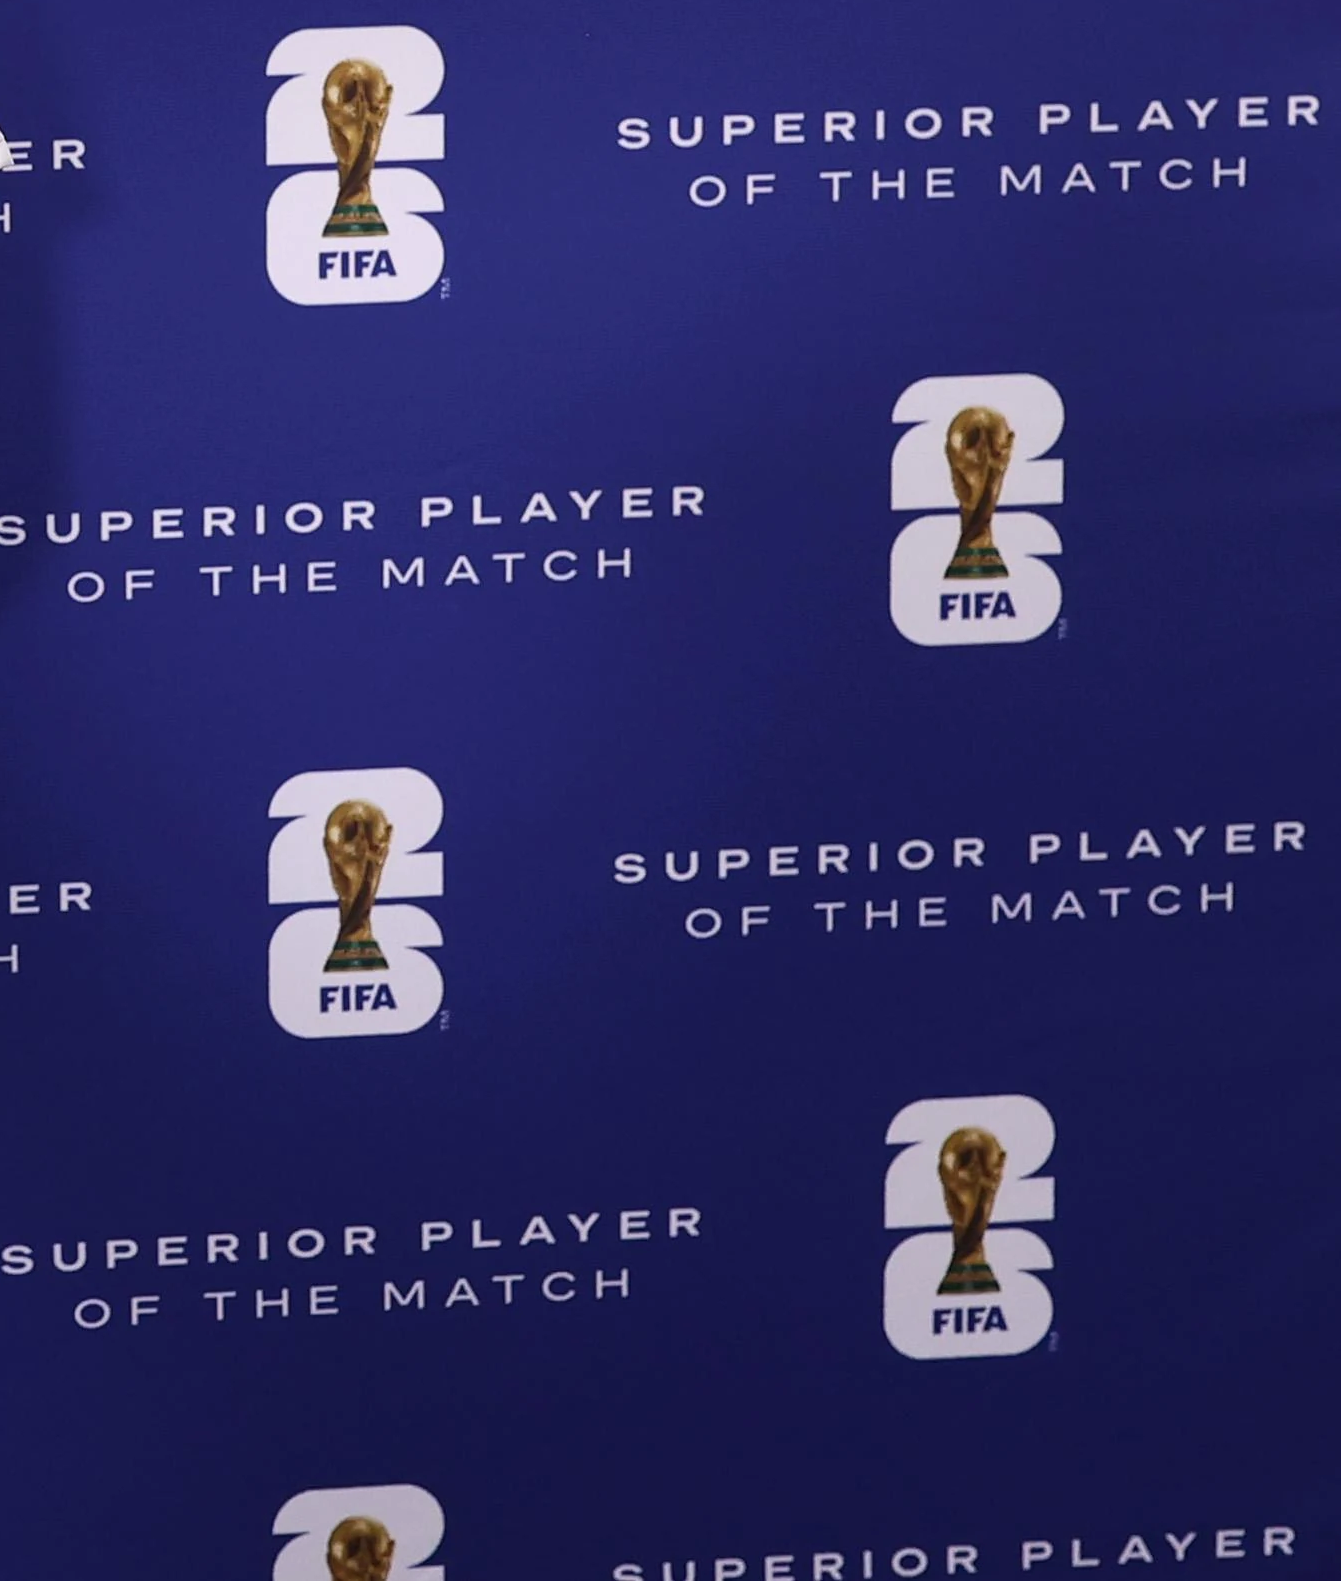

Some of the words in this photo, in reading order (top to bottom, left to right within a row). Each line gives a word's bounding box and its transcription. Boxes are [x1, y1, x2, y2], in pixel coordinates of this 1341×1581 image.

[617, 105, 994, 150] SUPERIOR
[1038, 94, 1320, 135] PLAYER
[689, 173, 776, 208] OF
[818, 166, 956, 203] THE
[1000, 156, 1247, 197] MATCH
[318, 249, 397, 280] FIFA
[420, 485, 705, 528] PLAYER
[67, 568, 156, 603] OF
[198, 560, 338, 597] THE
[382, 547, 632, 590] MATCH
[939, 591, 1016, 621] FIFA
[613, 837, 985, 884] SUPERIOR
[1029, 821, 1306, 864] PLAYER
[685, 905, 771, 939] OF
[813, 896, 947, 932] THE
[991, 881, 1234, 924] MATCH
[319, 983, 397, 1013] FIFA
[1, 1225, 377, 1276] SUPERIOR
[421, 1207, 701, 1252] PLAYER
[74, 1295, 160, 1329] OF
[203, 1285, 339, 1321] THE
[383, 1268, 629, 1311] MATCH
[932, 1305, 1008, 1335] FIFA
[1022, 1526, 1296, 1570] PLAYER
